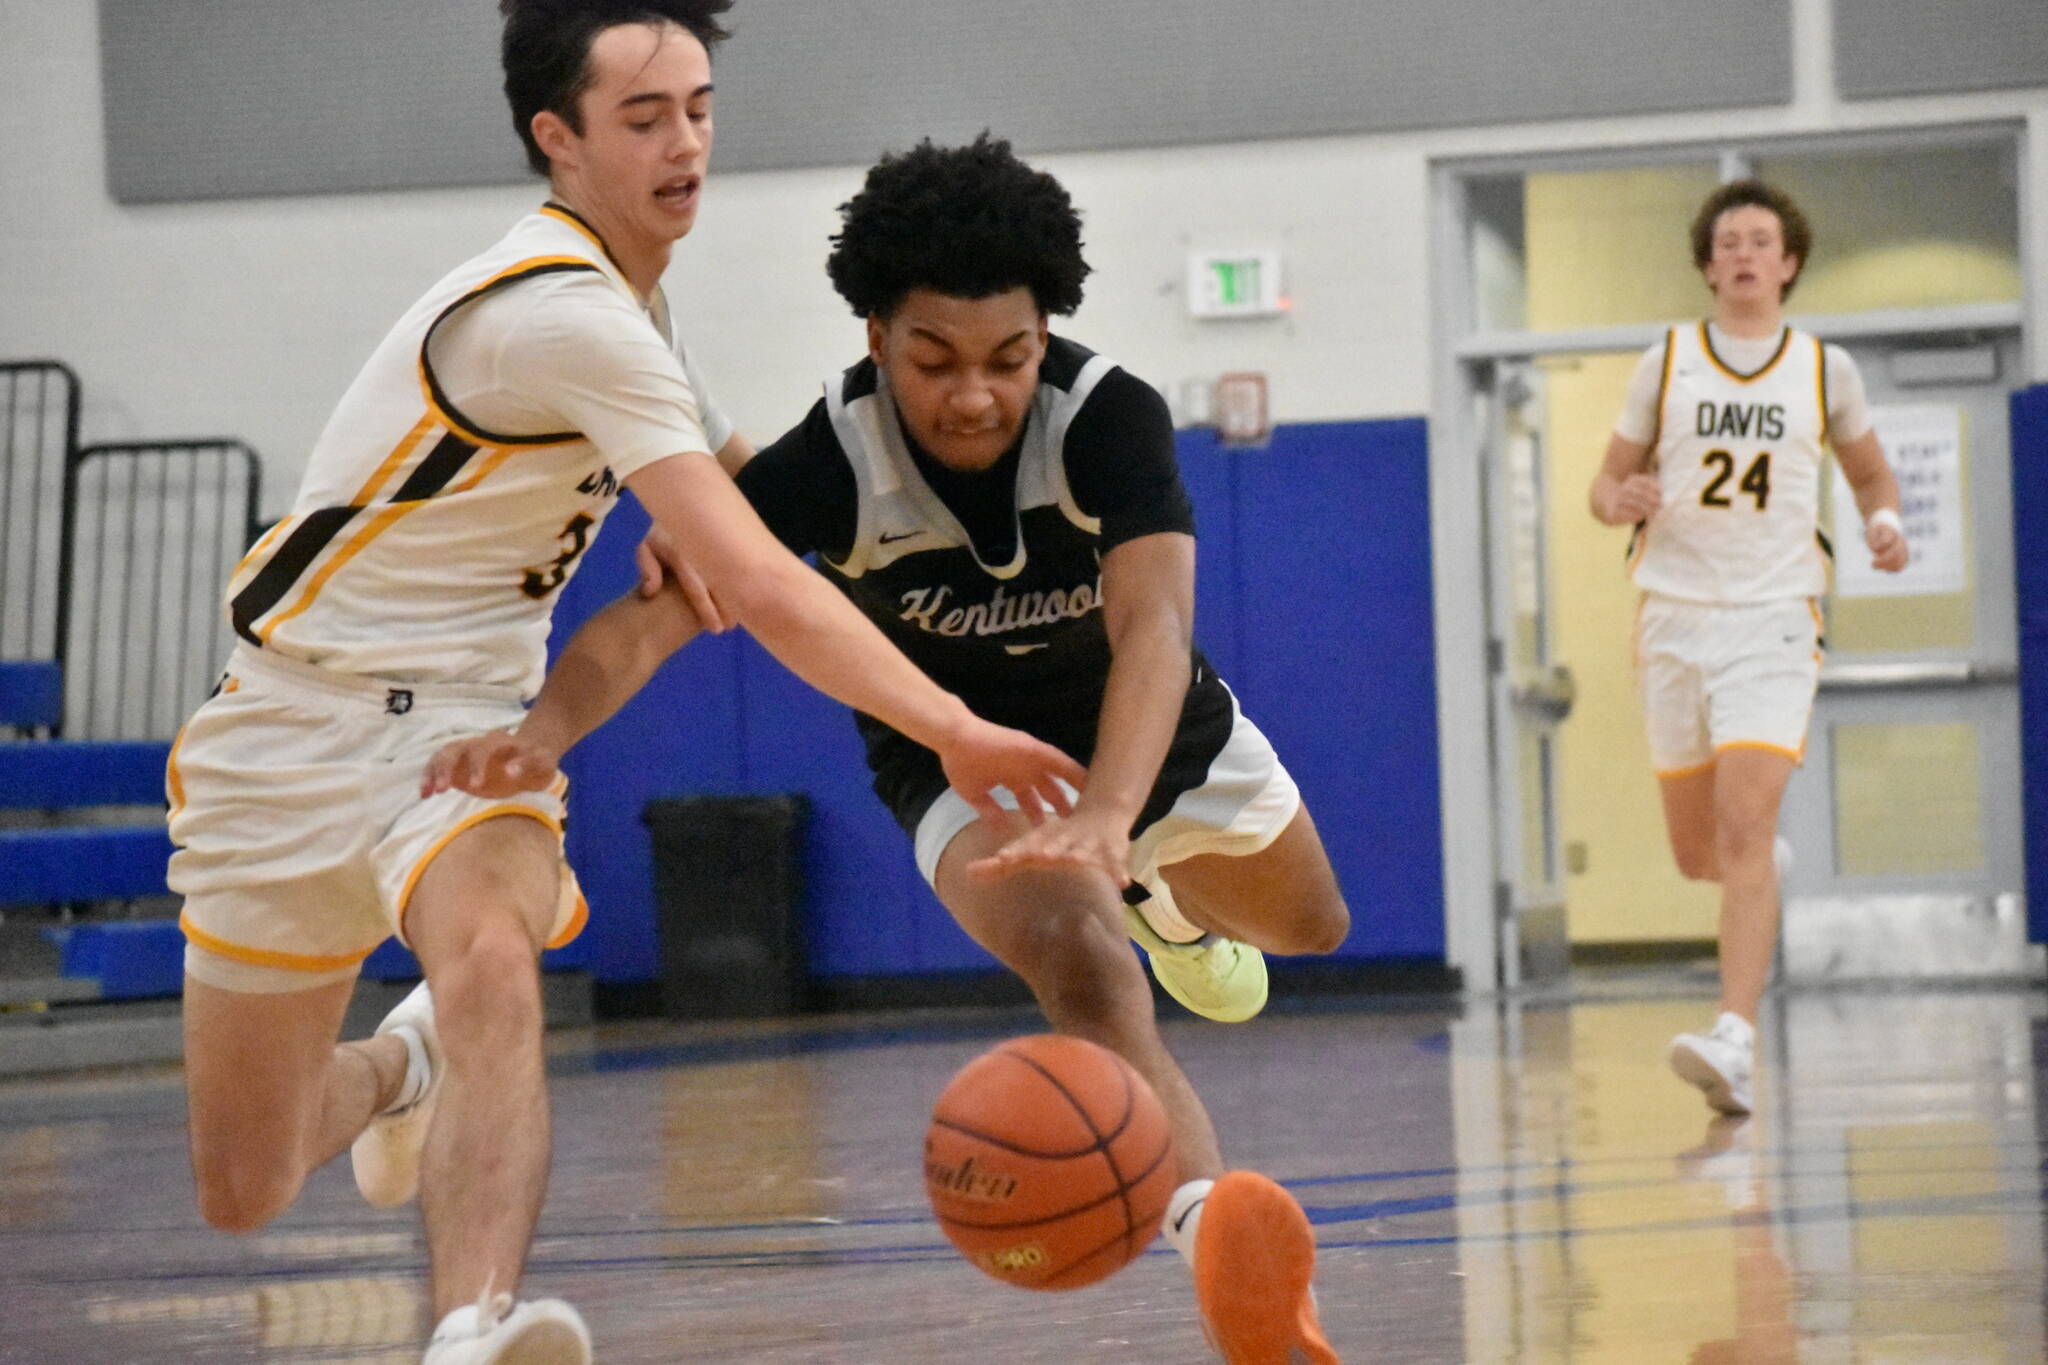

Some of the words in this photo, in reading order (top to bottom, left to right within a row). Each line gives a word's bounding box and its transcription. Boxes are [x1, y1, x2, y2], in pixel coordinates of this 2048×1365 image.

[1697, 401, 1784, 440] DAVIS
[1701, 449, 1770, 512] 24
[900, 574, 1104, 637] Kentwoo
